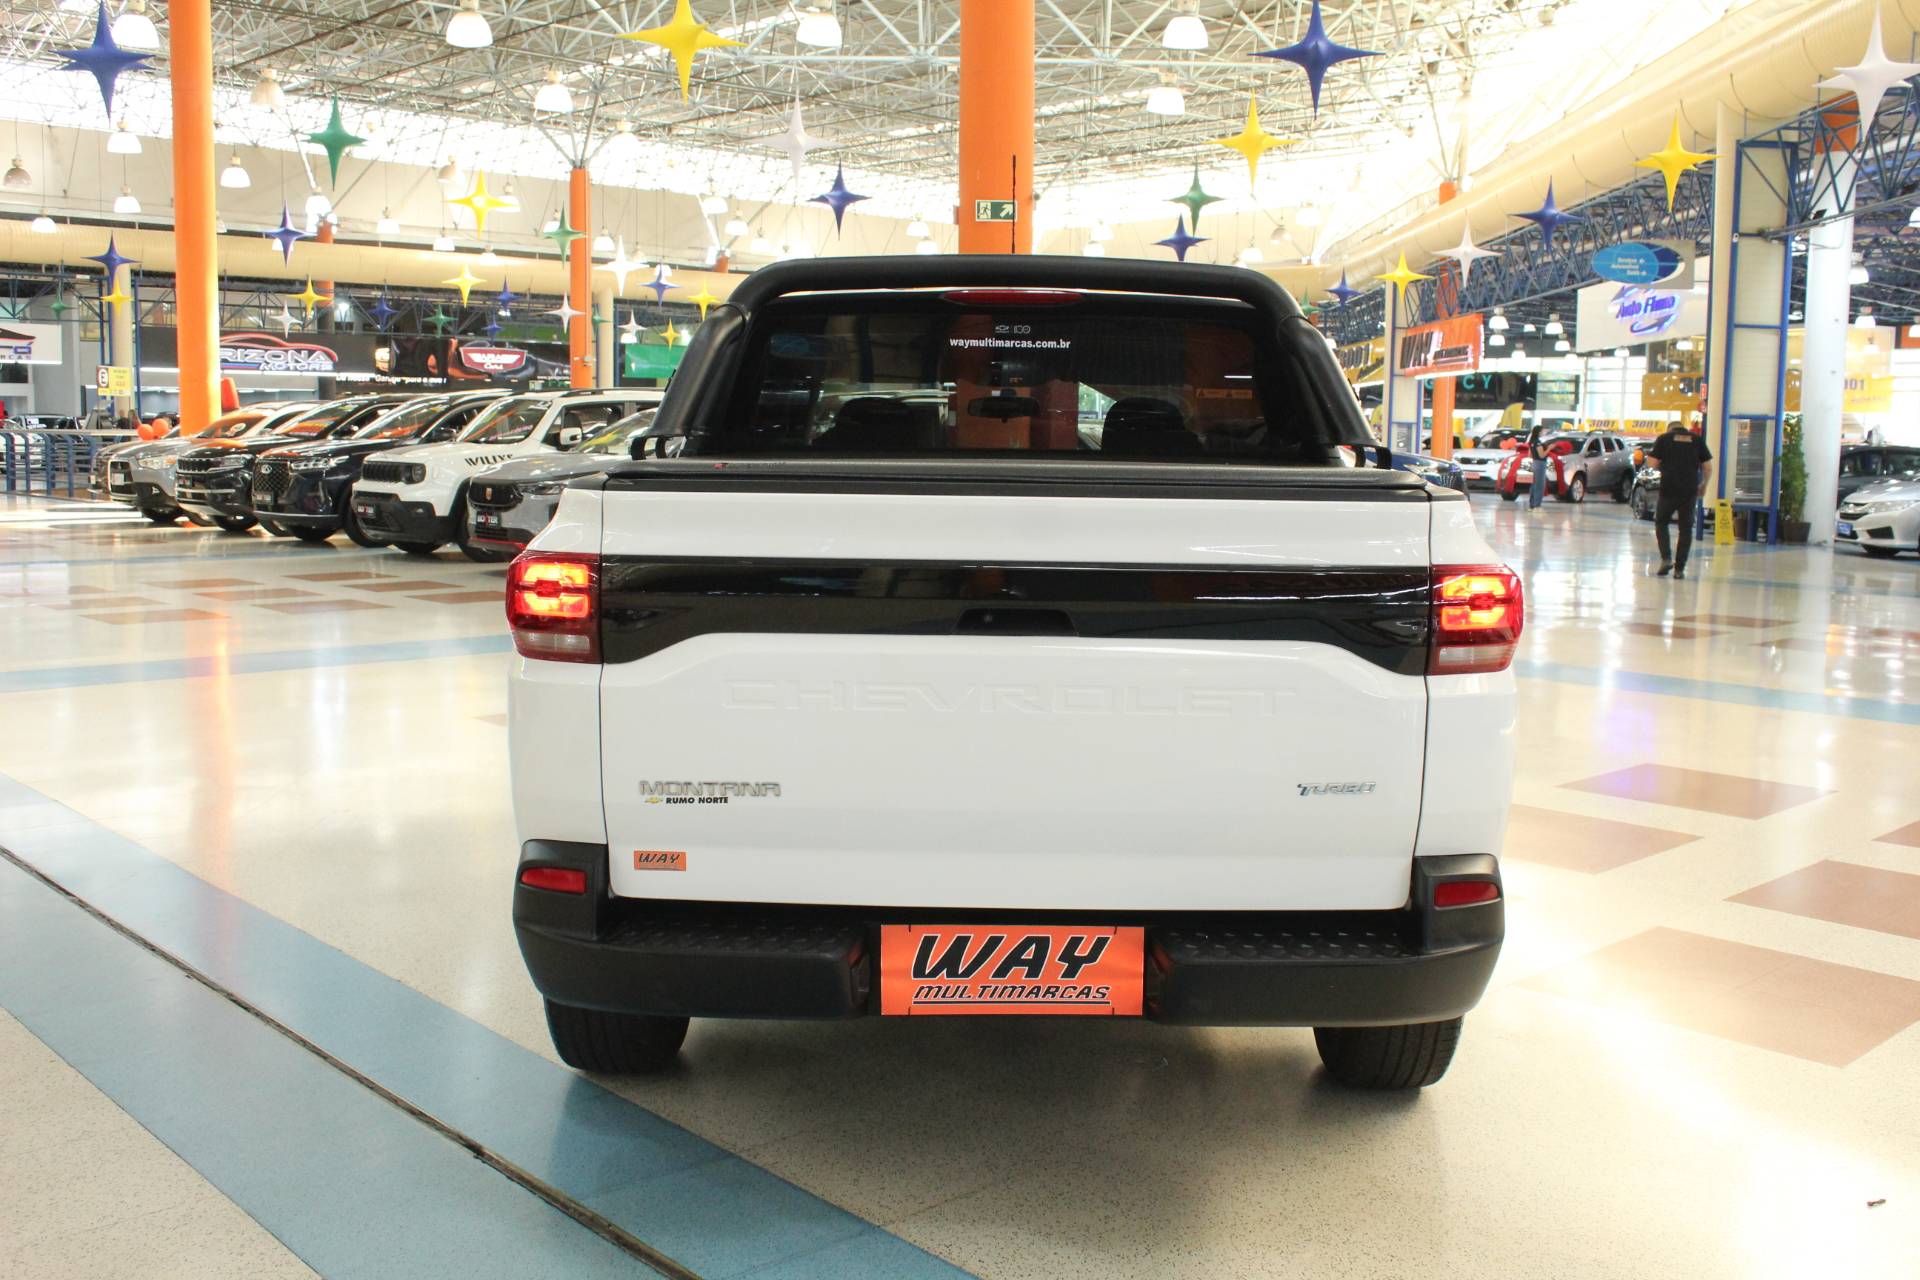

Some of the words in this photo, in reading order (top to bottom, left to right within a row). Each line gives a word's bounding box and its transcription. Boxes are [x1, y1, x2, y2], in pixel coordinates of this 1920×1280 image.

[950, 338, 1071, 348] waymultimarcas.com.br
[220, 347, 334, 363] RIZONA
[722, 679, 1297, 717] CHEVROLET
[639, 781, 781, 797] MONTANA
[1297, 782, 1376, 796] TURBO
[698, 796, 728, 804] NORTE
[638, 853, 680, 863] WAY
[911, 934, 1112, 980] WAY
[914, 984, 1111, 999] MULTIMARCAS
